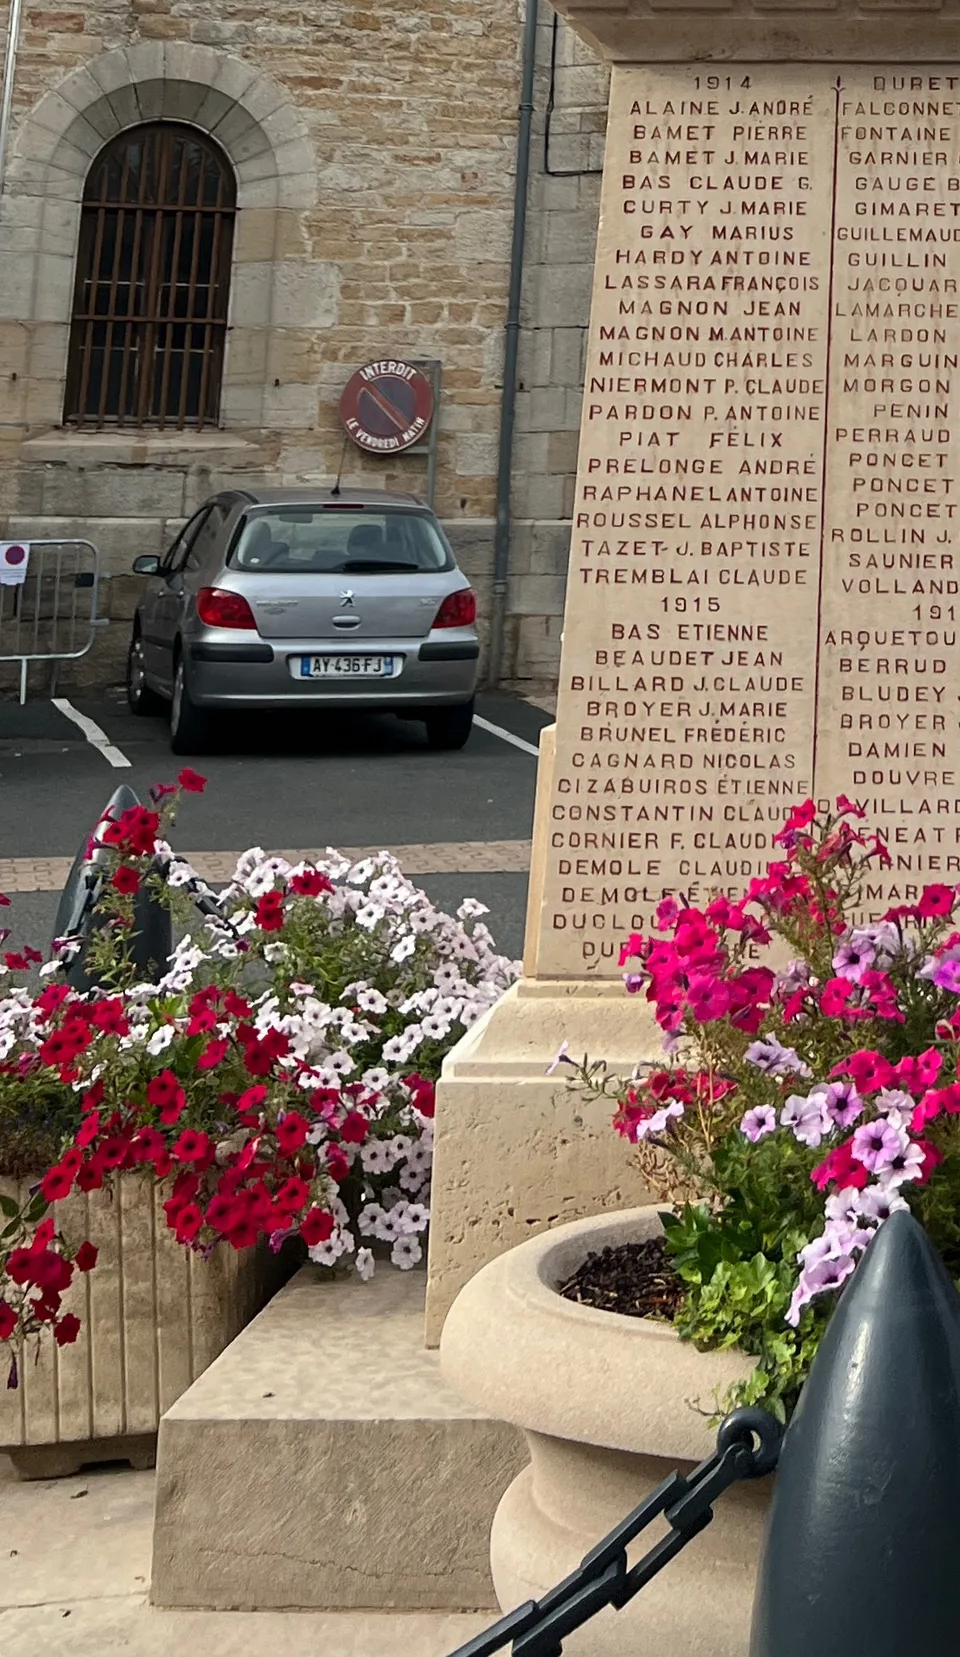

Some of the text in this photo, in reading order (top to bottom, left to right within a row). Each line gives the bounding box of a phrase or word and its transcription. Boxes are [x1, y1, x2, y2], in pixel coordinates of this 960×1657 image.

[695, 76, 751, 90] 1914
[874, 77, 959, 90] DURET
[633, 123, 715, 141] BAMET
[849, 151, 947, 165] GARNIER
[855, 202, 960, 216] GIMARET
[641, 225, 793, 240] GAY MARIUS
[616, 248, 810, 266] HARDY ANTOINE
[848, 253, 945, 267] GUILLIN
[605, 275, 819, 294] LASSARA FRANÇOIS
[619, 300, 800, 316] MAGNON JEAN
[851, 329, 945, 343] LARDON
[600, 352, 812, 368] MICHAUD CHARLES
[844, 353, 957, 371] MARGUIN
[360, 361, 417, 381] INTERDIT
[844, 379, 950, 394] MORGON
[346, 417, 359, 430] LE
[402, 416, 425, 442] MATIN
[836, 428, 949, 443] PERRAUD
[619, 432, 680, 447] PIAT
[588, 453, 815, 475] PRELONGE ANDRÉ
[849, 453, 948, 468] PONCET
[583, 486, 817, 502] RAPHANEL ANTOINE
[857, 503, 957, 518] PONCET
[577, 513, 816, 530] ROUSSEL ALPHONSE
[849, 553, 953, 569] SAUNIER
[580, 568, 807, 586] TREMBLAI CLAUDE
[842, 578, 958, 594] VOLLAND
[661, 597, 720, 612] 1915
[612, 623, 768, 642] BAS ETIENNE
[596, 650, 782, 668] BEAUDET JEAN
[840, 658, 946, 674] BERRUD
[581, 723, 676, 743] BRUNEL
[849, 742, 945, 759] DAMIEN
[572, 753, 795, 769] CAGNARD NICOLAS
[854, 770, 955, 785] DOUVRE
